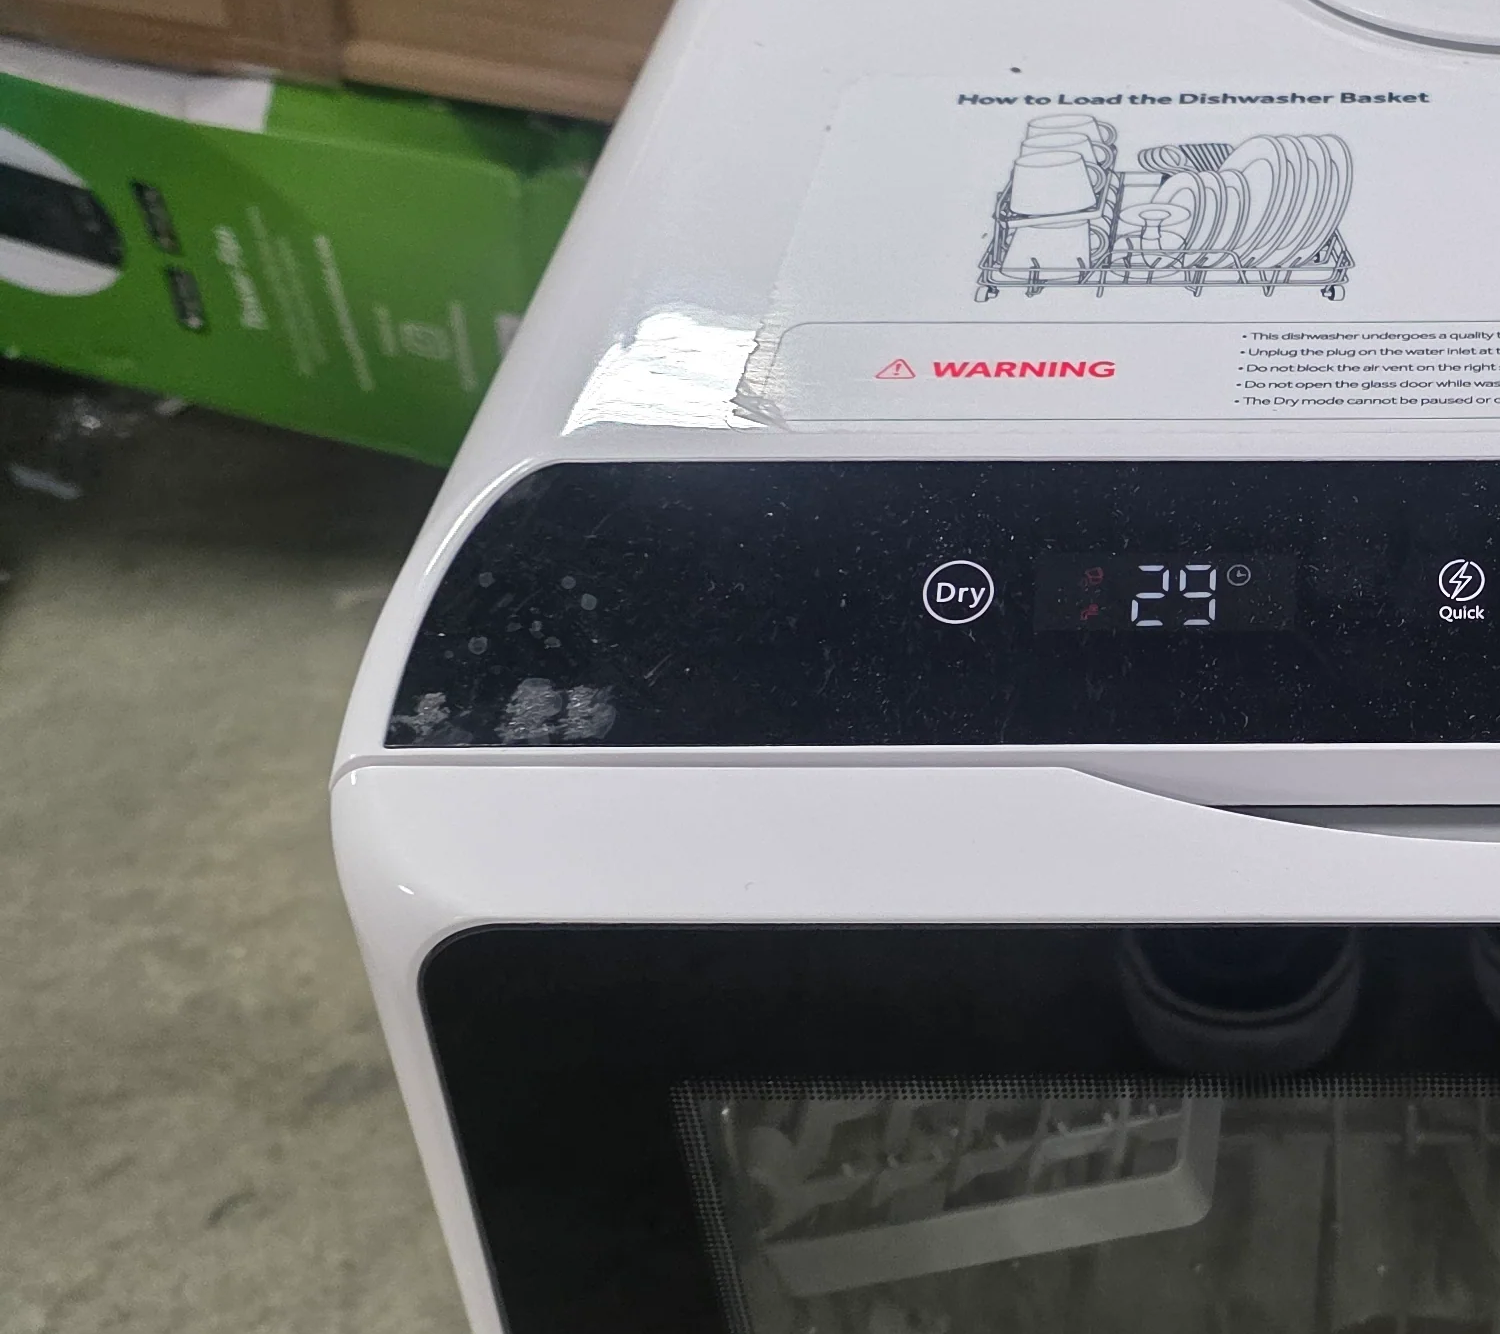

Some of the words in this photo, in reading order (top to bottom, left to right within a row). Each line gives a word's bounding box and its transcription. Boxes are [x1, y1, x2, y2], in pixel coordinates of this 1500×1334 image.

[957, 93, 1018, 106] How
[1024, 94, 1052, 106] to
[1058, 93, 1123, 106] Load
[1127, 92, 1173, 105] the
[1179, 92, 1335, 105] Dishwasher
[1340, 91, 1430, 104] Basket
[1251, 332, 1279, 341] This
[1281, 331, 1360, 341] dishwasher
[1361, 331, 1437, 342] undergoes
[1449, 331, 1494, 342] quality
[1248, 347, 1298, 359] Unplug
[1300, 348, 1324, 357] the
[1326, 348, 1356, 358] plug
[1379, 347, 1403, 356] the
[1405, 348, 1445, 356] water
[1447, 347, 1477, 356] inlet
[1478, 347, 1493, 356] at
[933, 361, 1116, 378] WARNING
[1246, 364, 1268, 373] Do
[1270, 364, 1295, 373] not
[1296, 363, 1334, 373] block
[1337, 363, 1361, 373] the
[1362, 364, 1380, 372] air
[1382, 363, 1414, 372] vent
[1438, 363, 1462, 372] the
[1464, 362, 1497, 374] right
[1244, 380, 1266, 389] Do
[1268, 381, 1293, 389] not
[1295, 381, 1332, 391] open
[1335, 379, 1359, 389] the
[1361, 379, 1397, 391] glass
[1399, 379, 1434, 389] door
[1436, 379, 1472, 388] while
[1243, 396, 1271, 406] The
[1273, 396, 1300, 408] Dry
[1301, 396, 1345, 406] mode
[1346, 397, 1398, 405] cannot
[1400, 396, 1418, 405] be
[1420, 395, 1473, 407] paused
[1475, 397, 1492, 405] or
[935, 581, 986, 609] Dry
[1131, 564, 1217, 627] 29
[1438, 605, 1485, 622] Quick
